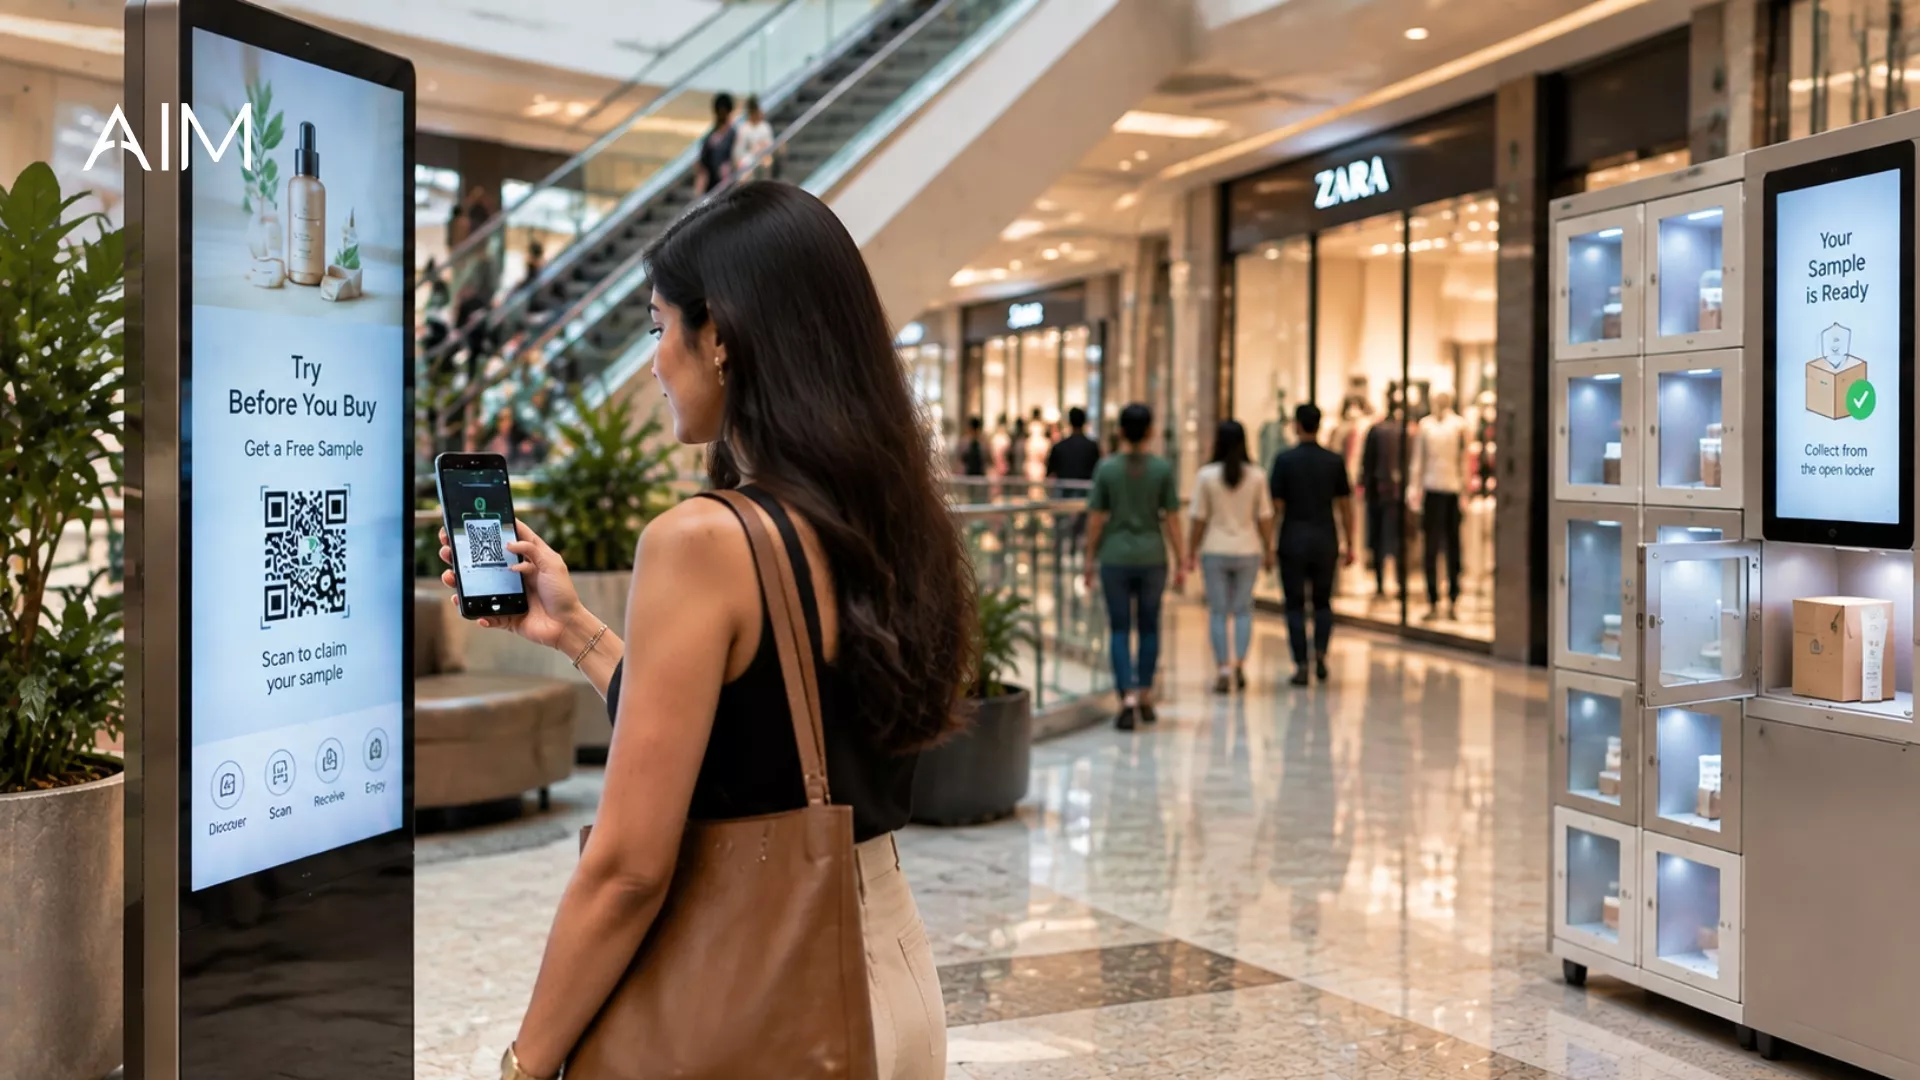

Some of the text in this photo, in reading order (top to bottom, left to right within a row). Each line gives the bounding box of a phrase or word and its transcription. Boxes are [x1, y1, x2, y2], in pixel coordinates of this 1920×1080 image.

[1313, 154, 1390, 210] ZARA
[1820, 231, 1852, 249] Your
[1808, 253, 1866, 278] Sample
[1806, 280, 1869, 304] is Ready
[291, 354, 322, 387] Try
[229, 389, 377, 424] Before You Buy
[244, 439, 364, 460] Get a Free Sample
[1804, 443, 1868, 457] Collect from
[1800, 462, 1875, 478] the open locker
[262, 641, 347, 668] Scan to claim
[266, 664, 344, 695] your sample
[314, 790, 346, 807] Receive
[269, 805, 292, 820] Scan
